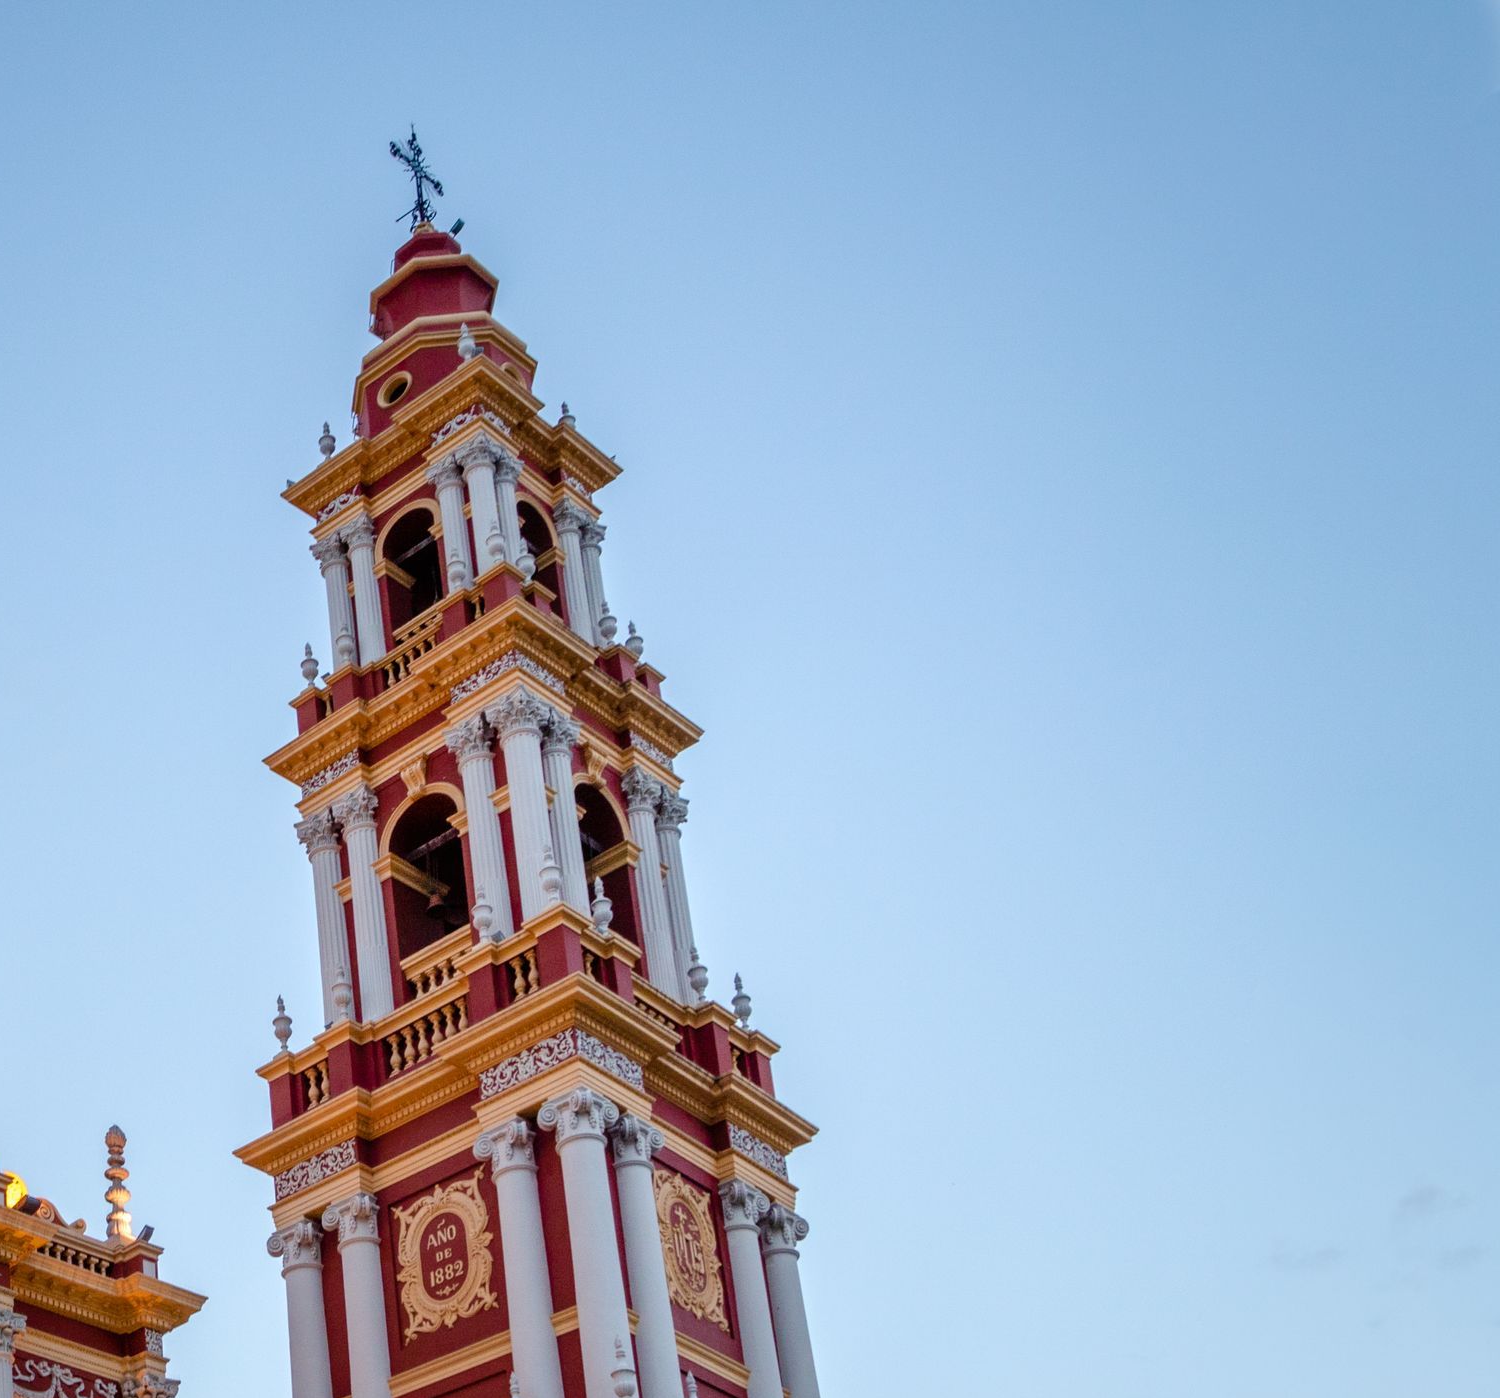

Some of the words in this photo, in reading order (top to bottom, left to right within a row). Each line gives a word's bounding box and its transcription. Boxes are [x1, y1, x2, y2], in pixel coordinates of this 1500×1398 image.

[427, 1218, 457, 1250] AÑO
[435, 1248, 452, 1262] DE
[430, 1260, 464, 1288] 1882
